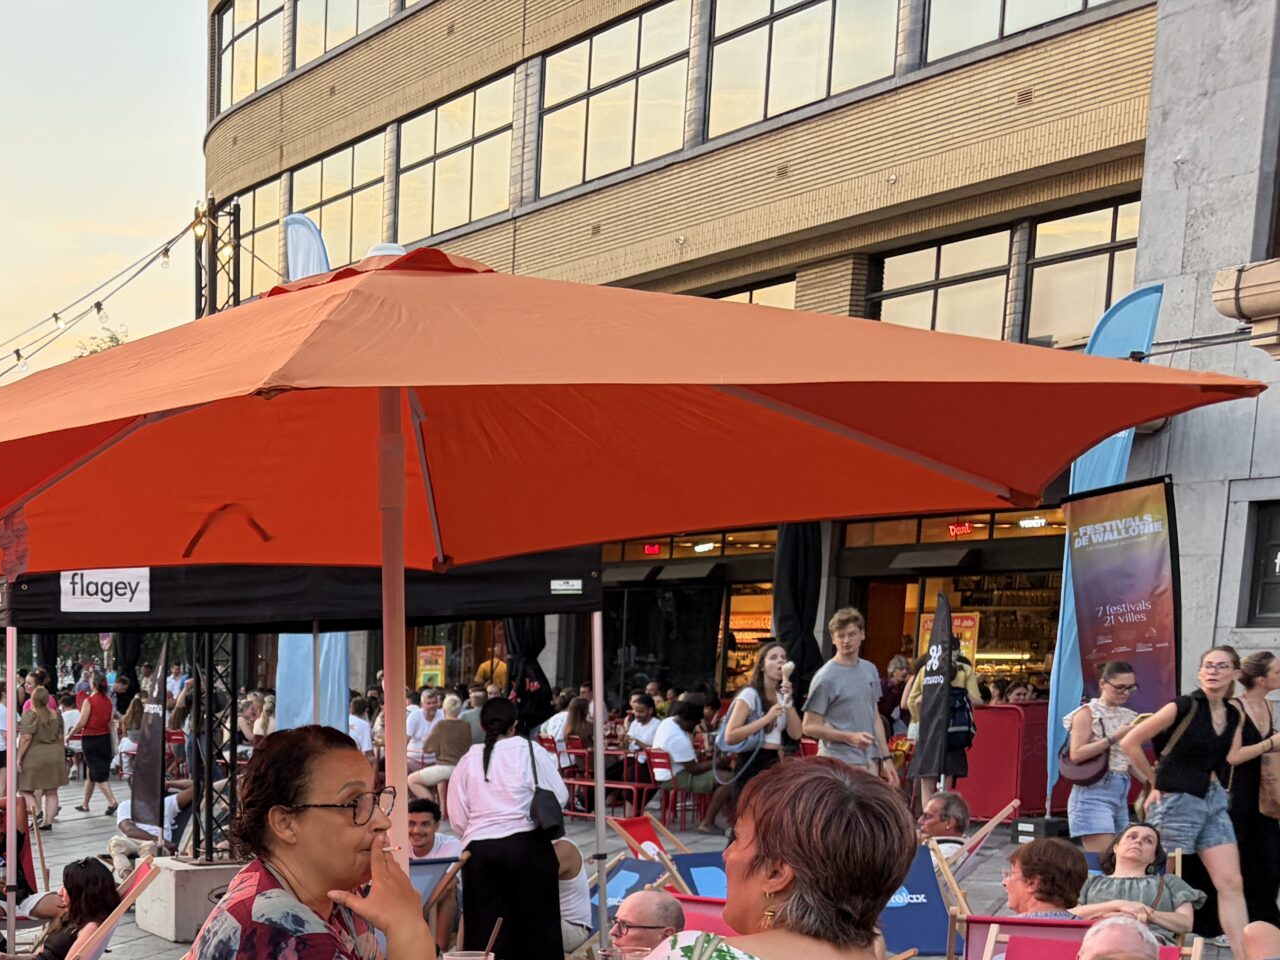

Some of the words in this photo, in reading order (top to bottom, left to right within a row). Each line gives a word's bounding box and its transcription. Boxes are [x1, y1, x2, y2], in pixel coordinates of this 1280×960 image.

[1074, 535, 1089, 549] DE
[1091, 521, 1163, 544] WALLONIE
[1079, 513, 1152, 537] FESTIVALS
[70, 572, 141, 603] flagey
[1095, 606, 1104, 618] 7
[1106, 600, 1152, 616] festivals
[1104, 615, 1115, 627] 21
[1118, 612, 1147, 624] villes
